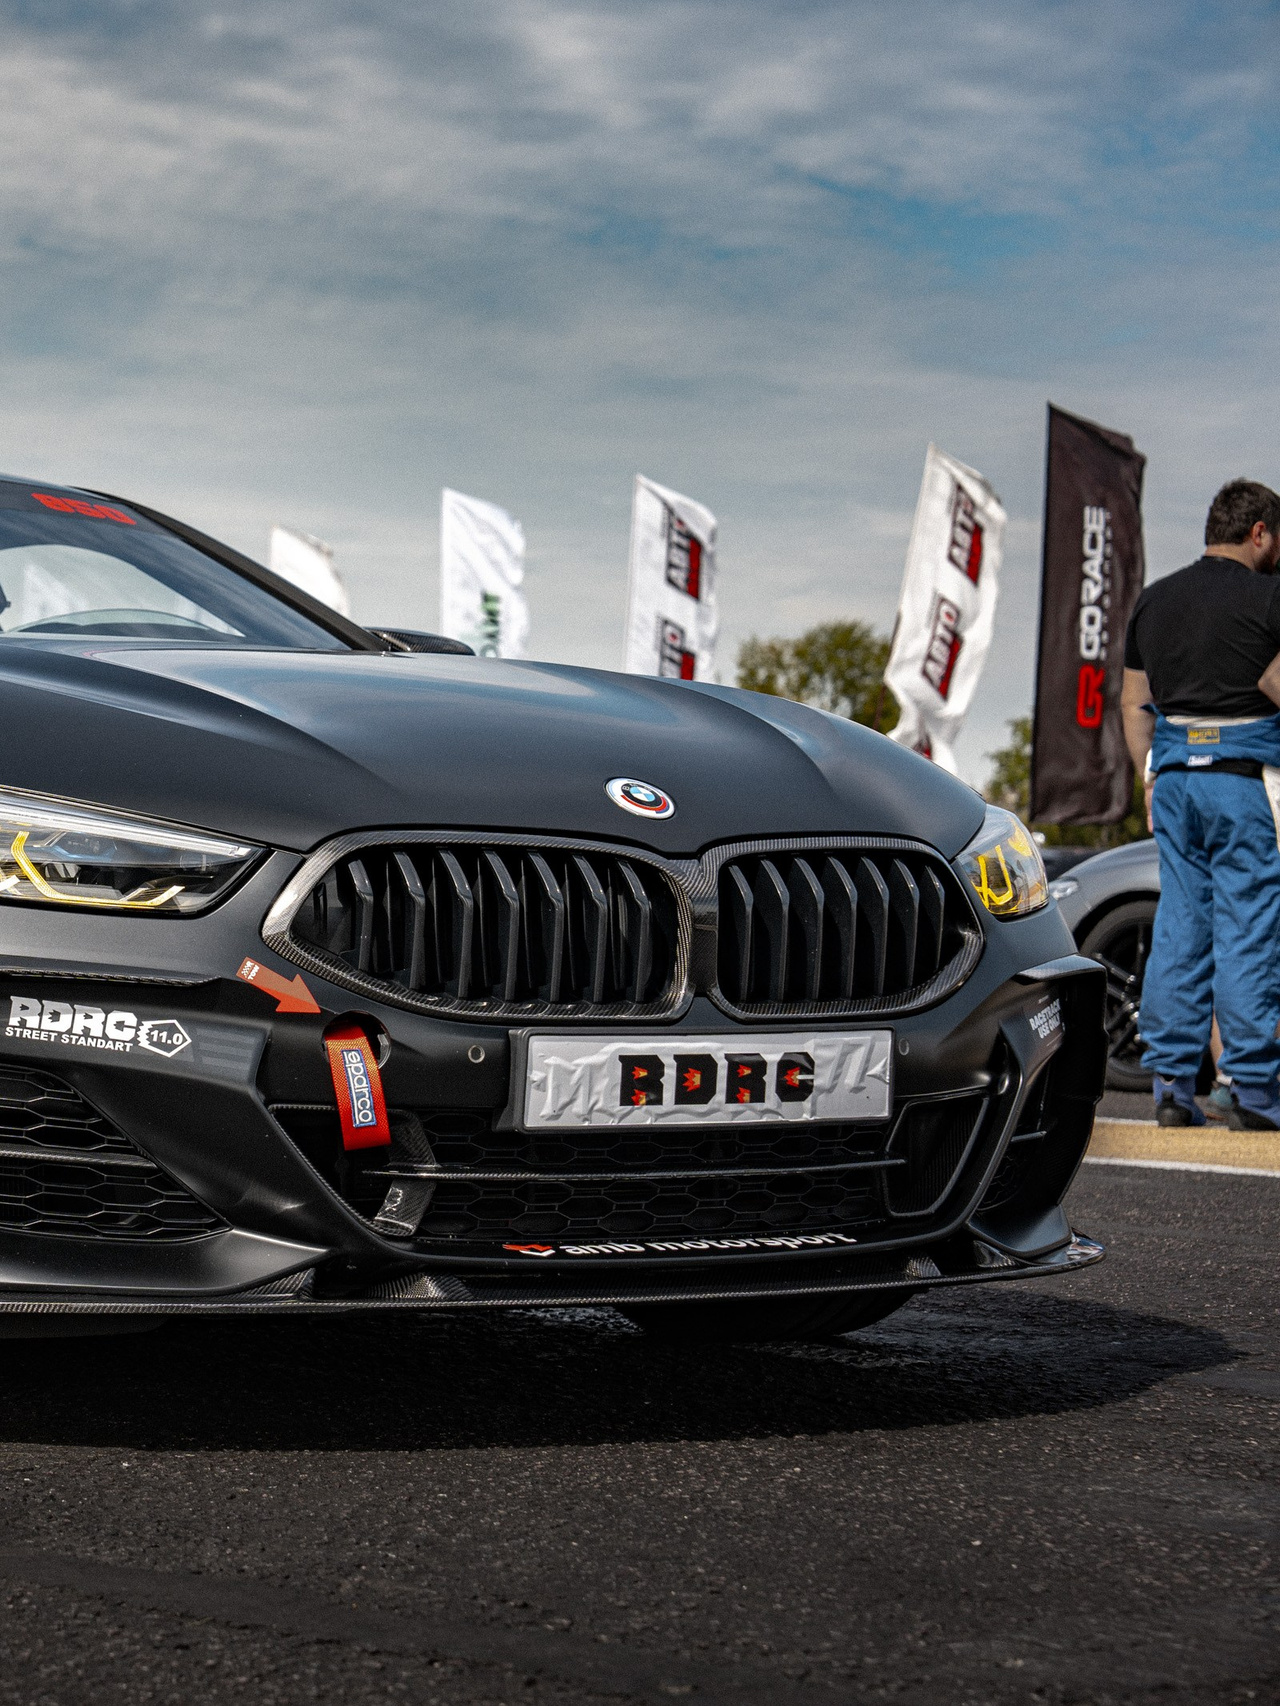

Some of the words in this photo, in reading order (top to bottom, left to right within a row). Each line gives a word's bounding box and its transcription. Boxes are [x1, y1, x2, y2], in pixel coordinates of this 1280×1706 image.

[8, 995, 138, 1041] RDRC
[5, 1027, 58, 1042] STREET
[61, 1034, 133, 1052] STANDART
[150, 1030, 184, 1046] 11.0
[345, 1049, 374, 1124] sparco
[618, 1052, 815, 1107] RDRC
[559, 1241, 645, 1256] amb
[645, 1231, 858, 1252] motorsport
